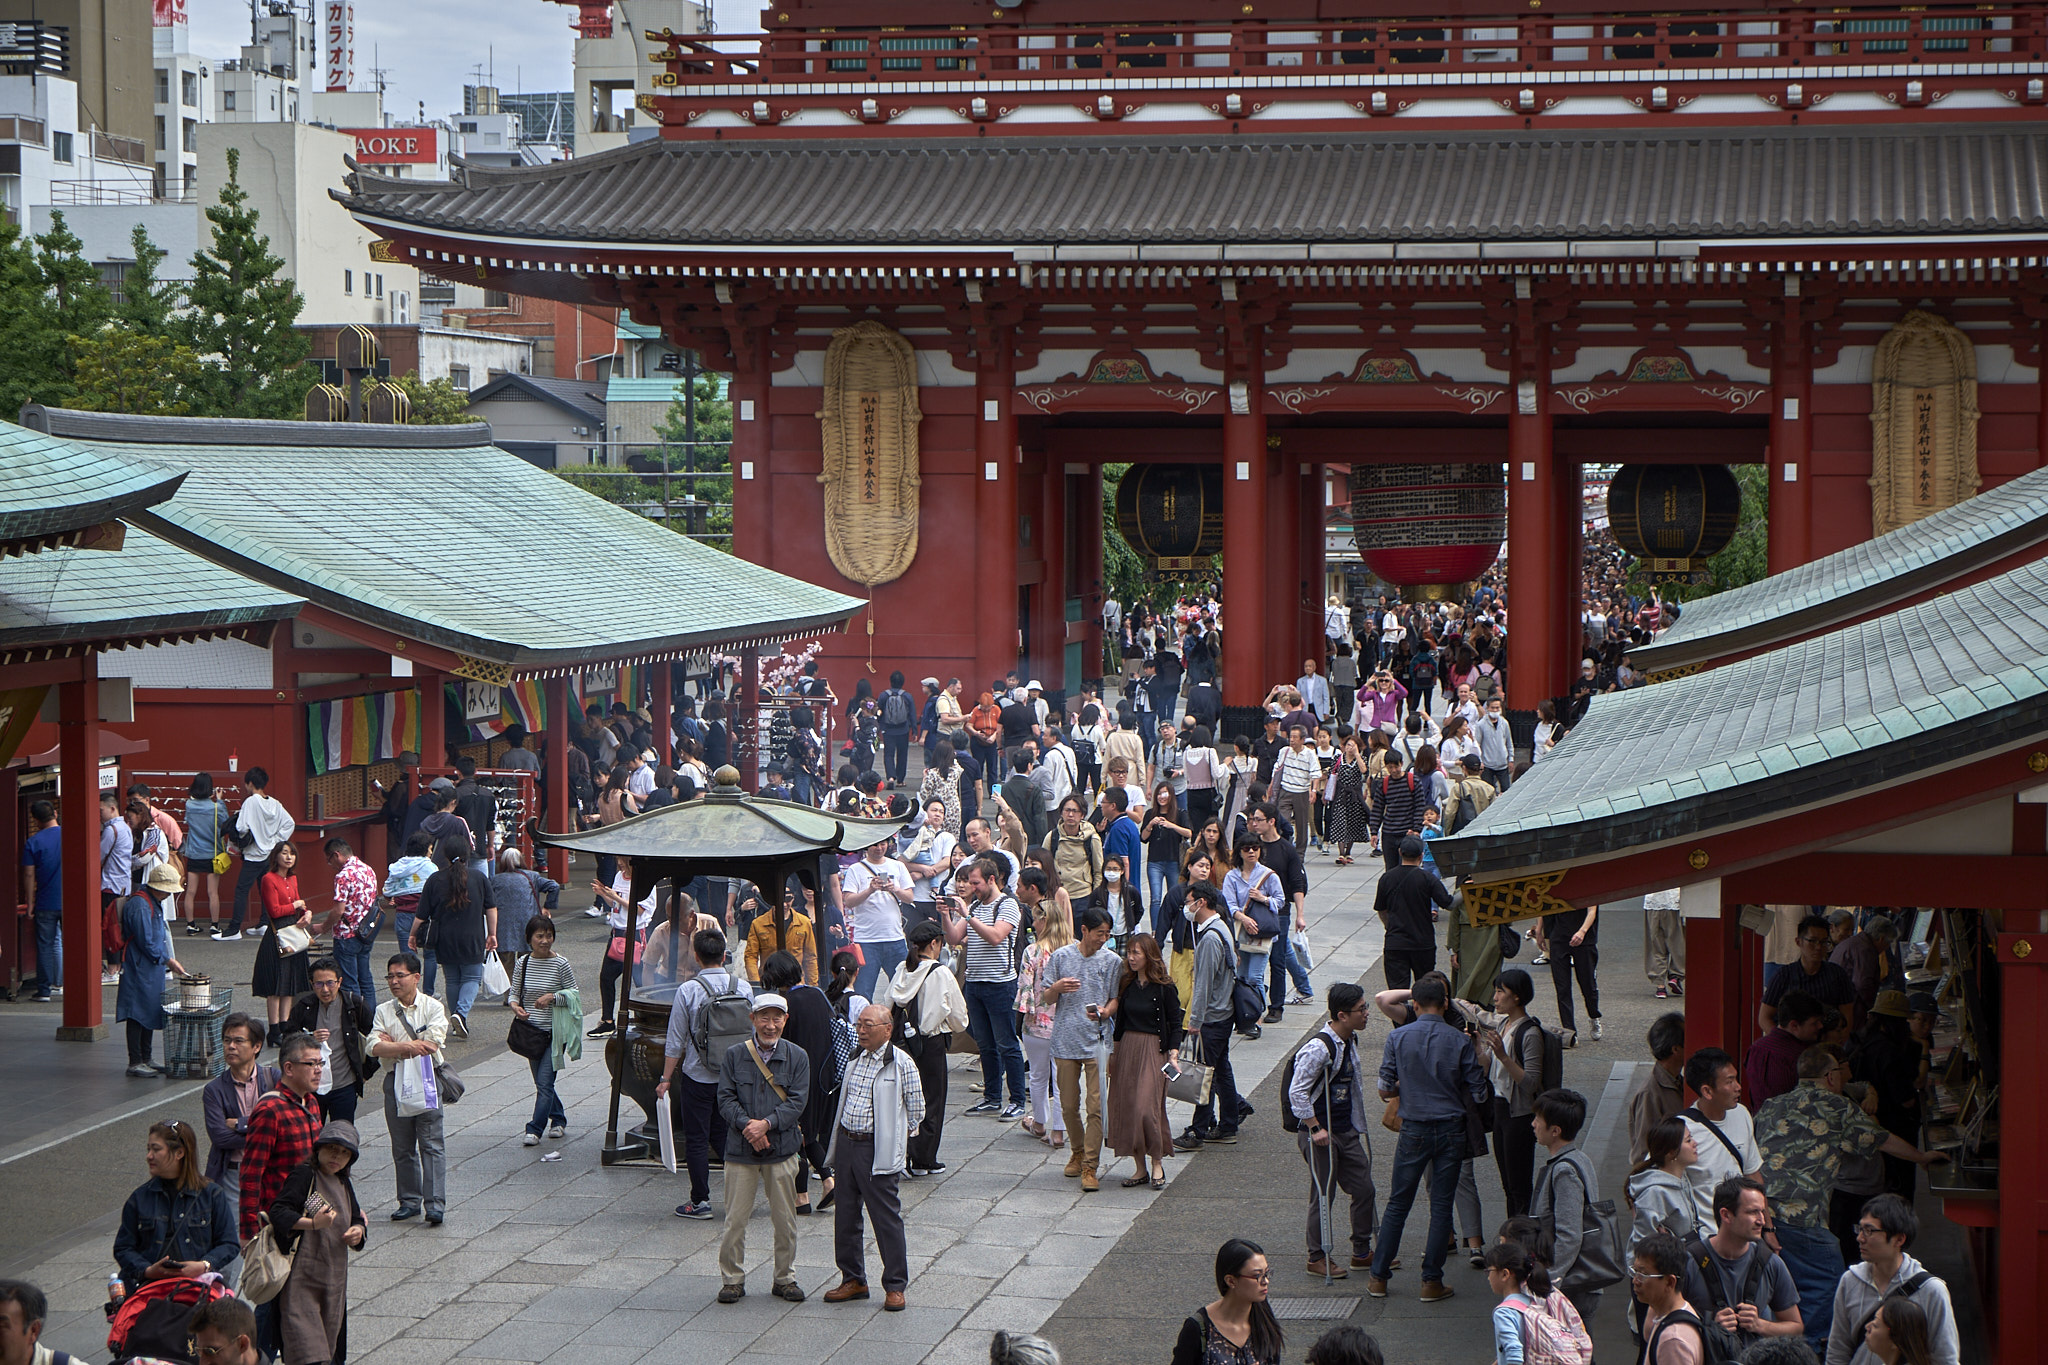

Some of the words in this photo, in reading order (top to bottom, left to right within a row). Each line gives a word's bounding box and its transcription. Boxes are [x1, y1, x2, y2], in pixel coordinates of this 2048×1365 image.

[329, 4, 343, 86] カラオケ
[356, 138, 419, 155] AOKE
[468, 684, 497, 712] みくじ
[100, 774, 114, 787] 100円
